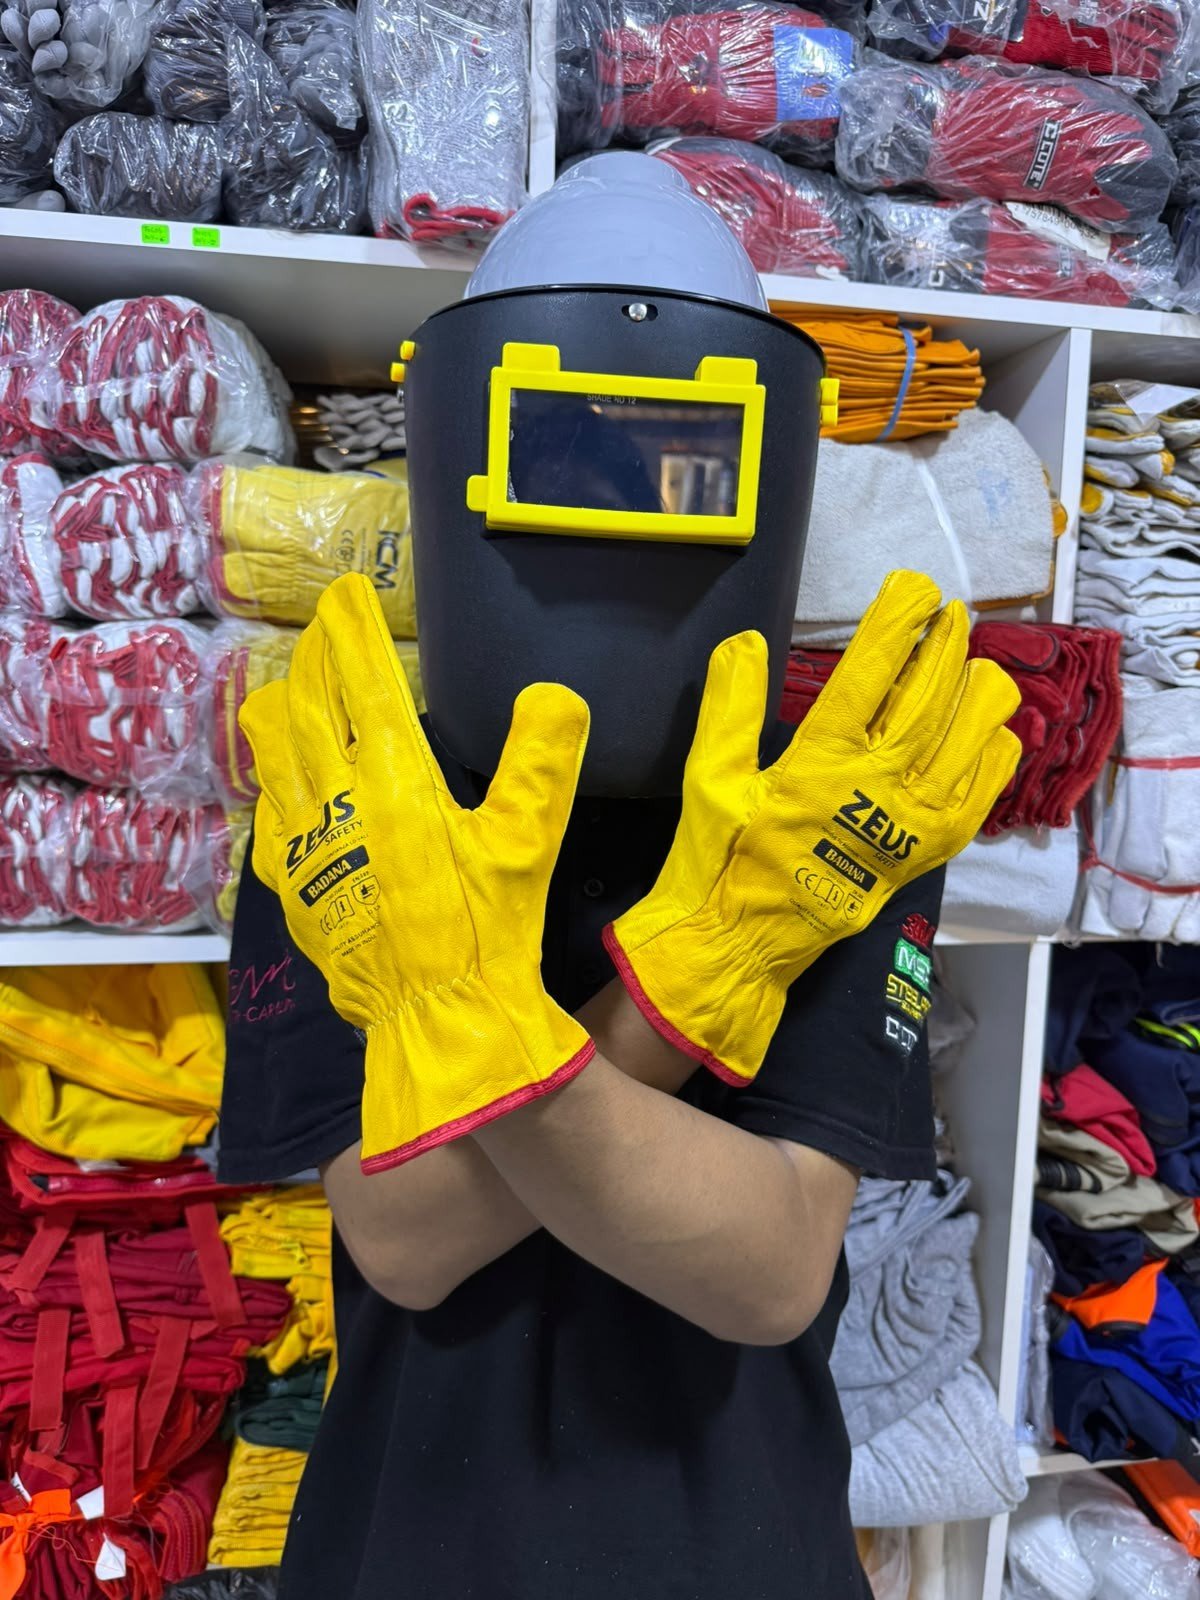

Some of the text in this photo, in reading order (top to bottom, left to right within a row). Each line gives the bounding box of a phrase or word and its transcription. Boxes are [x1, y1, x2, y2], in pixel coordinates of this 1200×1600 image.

[587, 394, 611, 403] SHADE
[628, 397, 637, 405] 12
[325, 819, 364, 847] SAFETY
[839, 789, 919, 861] ZEUS
[824, 848, 866, 884] BADANA
[873, 853, 899, 869] SAFETY
[307, 859, 352, 899] BADANA
